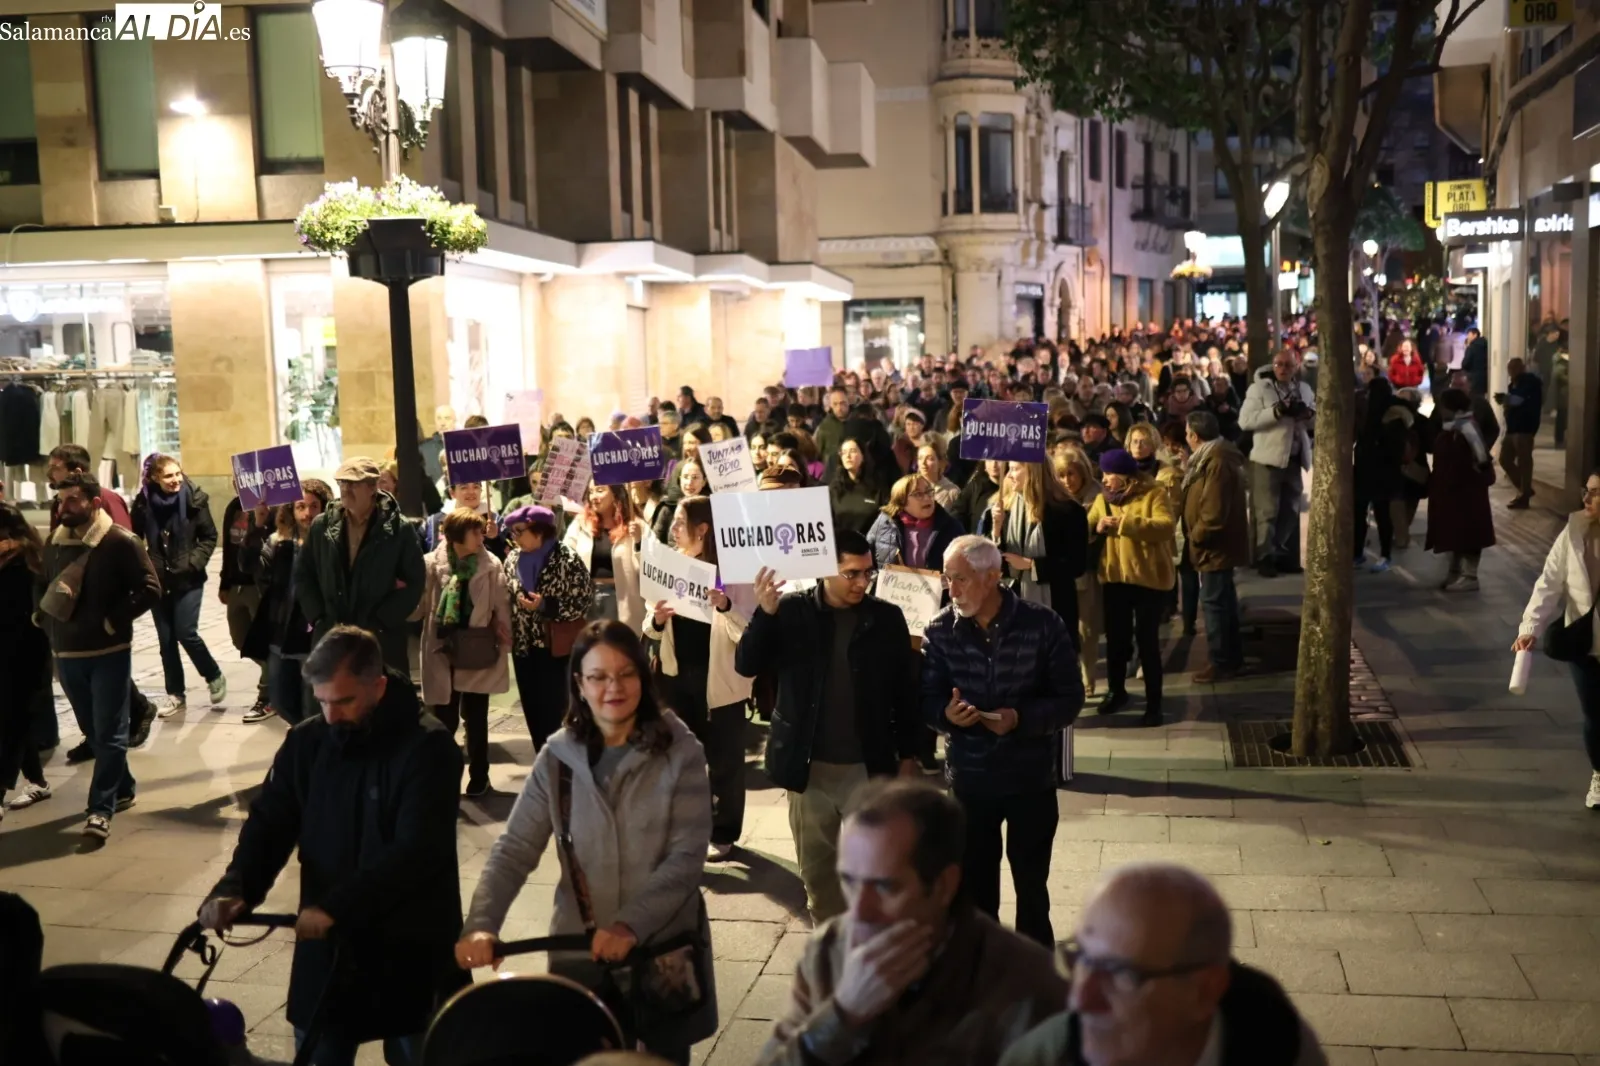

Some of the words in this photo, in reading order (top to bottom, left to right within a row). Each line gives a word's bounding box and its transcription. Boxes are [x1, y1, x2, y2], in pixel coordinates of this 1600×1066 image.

[1524, 1, 1558, 23] ORO
[1447, 190, 1476, 203] PLATA
[1446, 215, 1519, 237] Bershka
[449, 443, 519, 464] LUCHADORAS
[593, 445, 659, 466] LUCHADORAS
[720, 521, 826, 554] LUCHADORAS
[642, 560, 709, 600] LUCHADORAS
